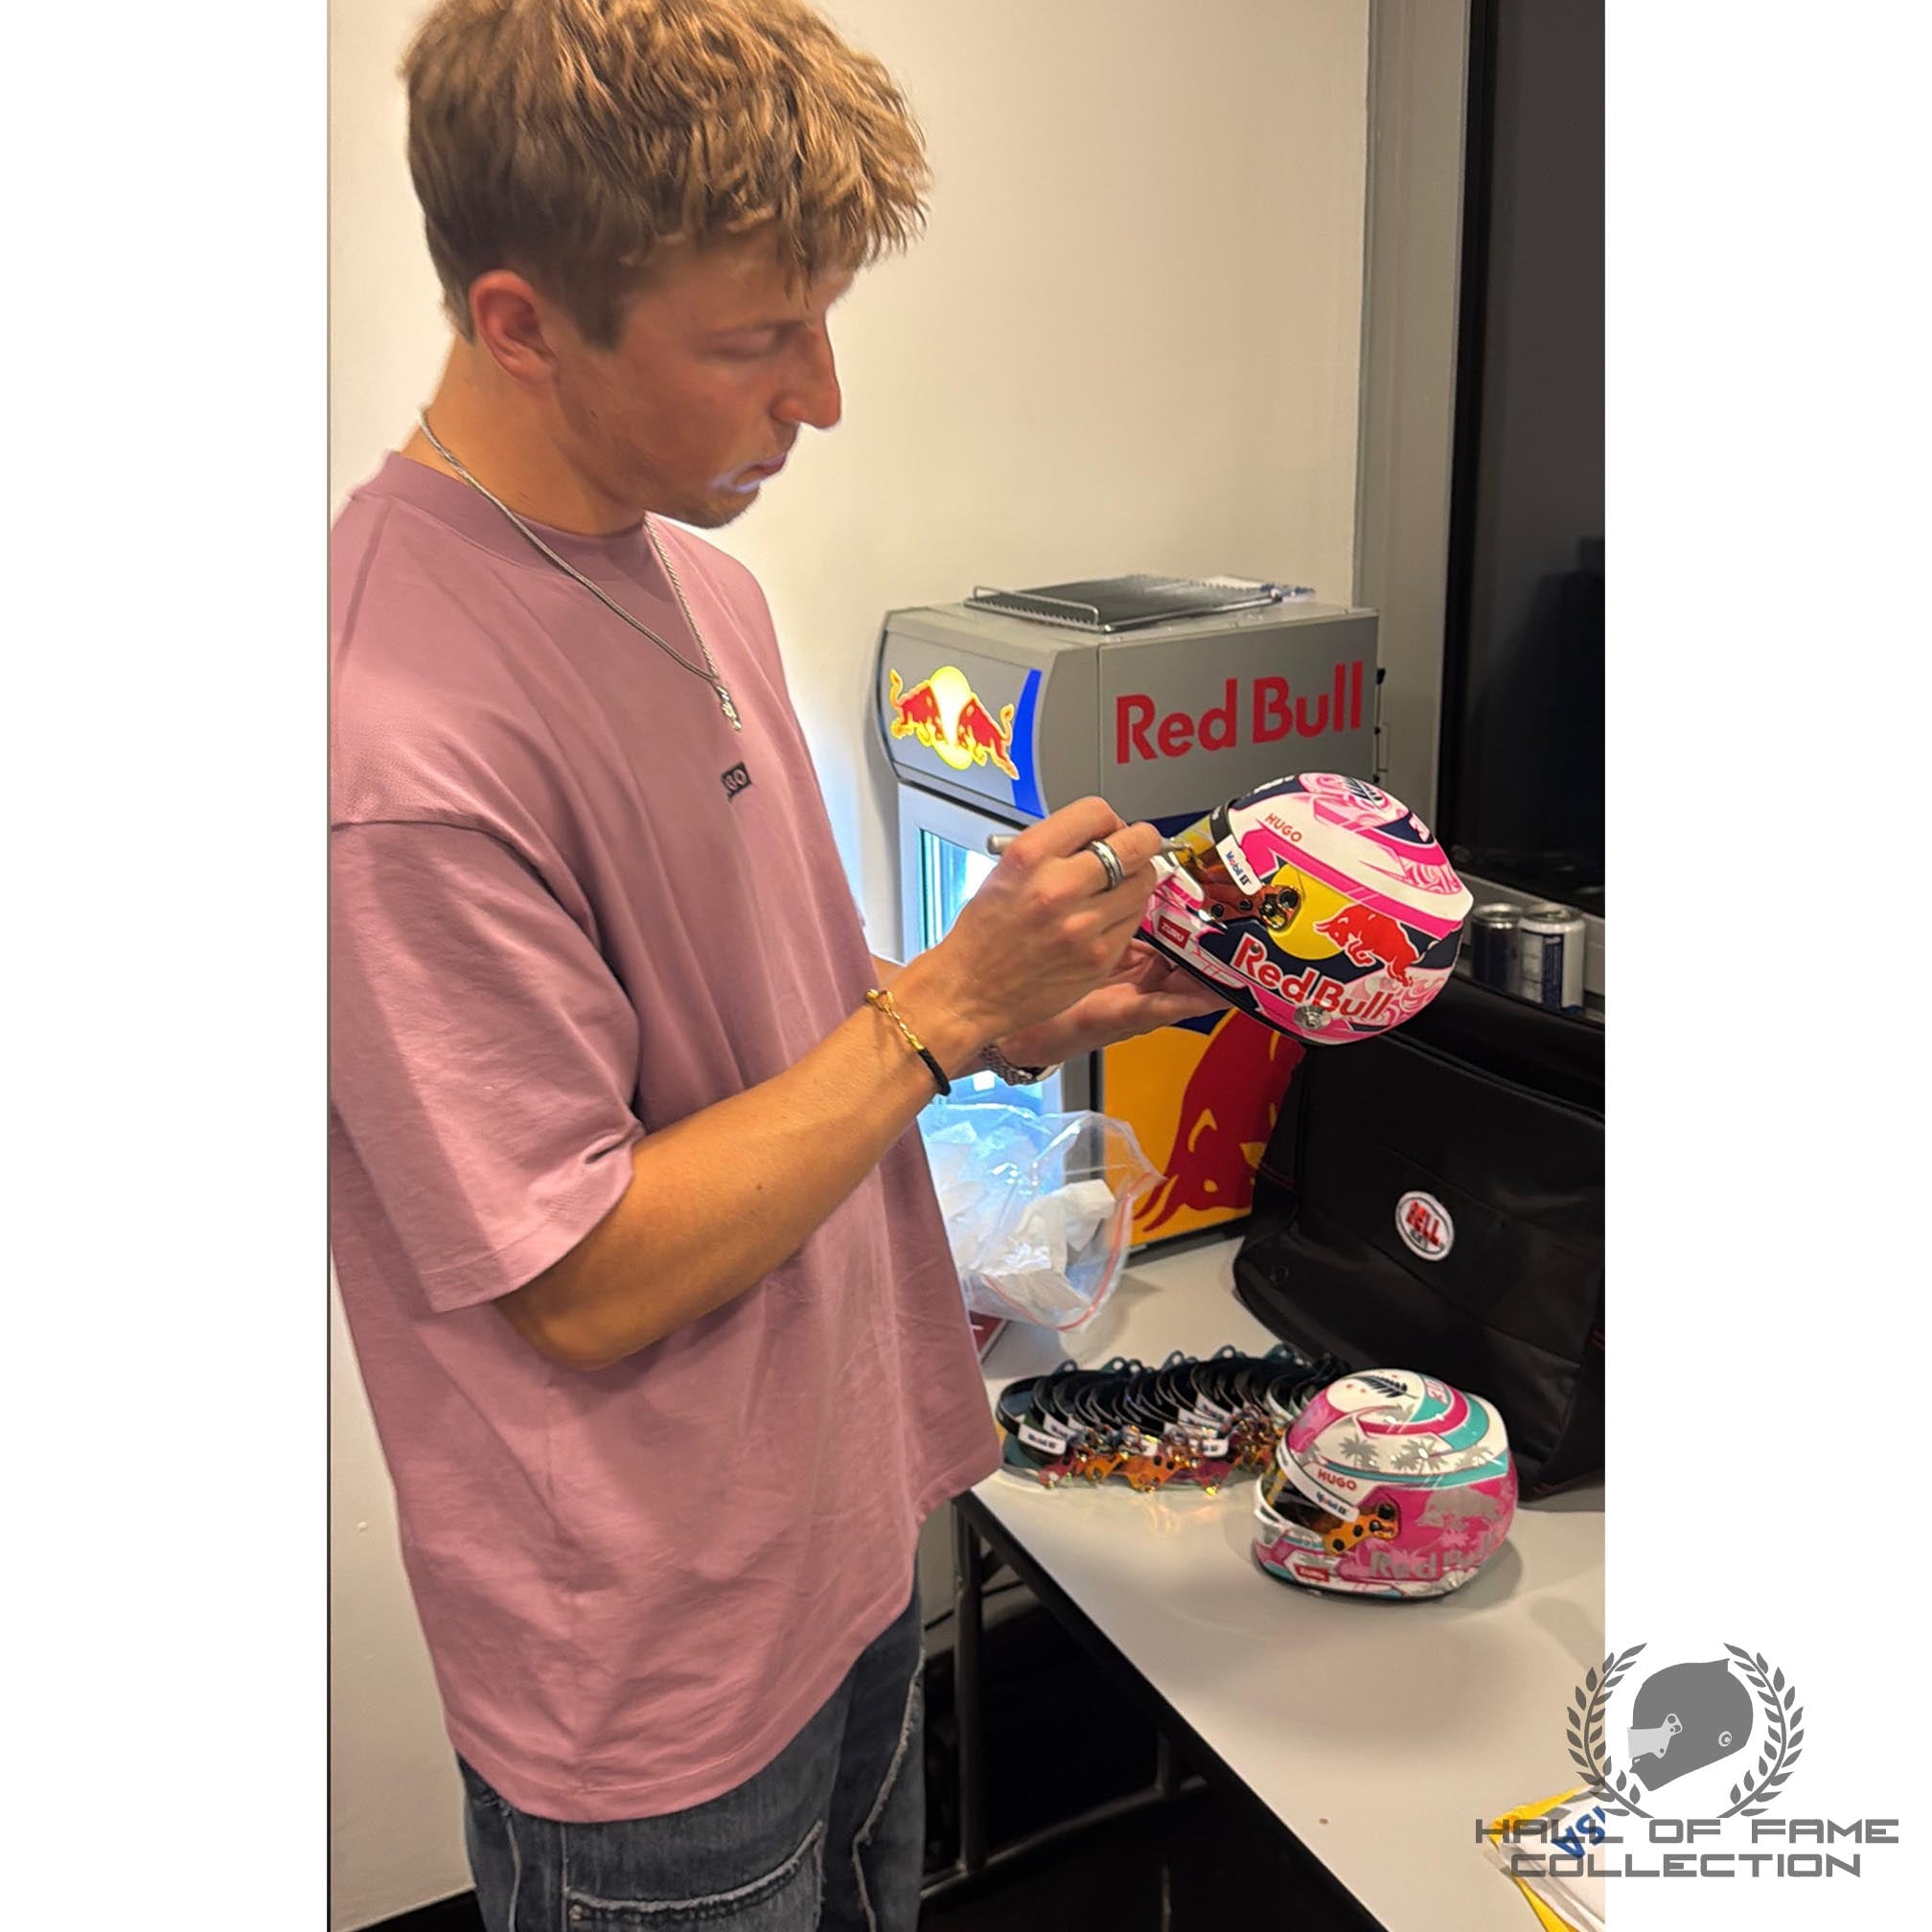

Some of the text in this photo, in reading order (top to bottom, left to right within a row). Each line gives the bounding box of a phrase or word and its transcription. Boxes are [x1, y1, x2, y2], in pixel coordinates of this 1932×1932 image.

[1116, 660, 1364, 765] Red Bull
[1264, 813, 1302, 842] HUGO
[1231, 934, 1392, 1021] Red Bull
[1317, 1468, 1358, 1492] HUGO
